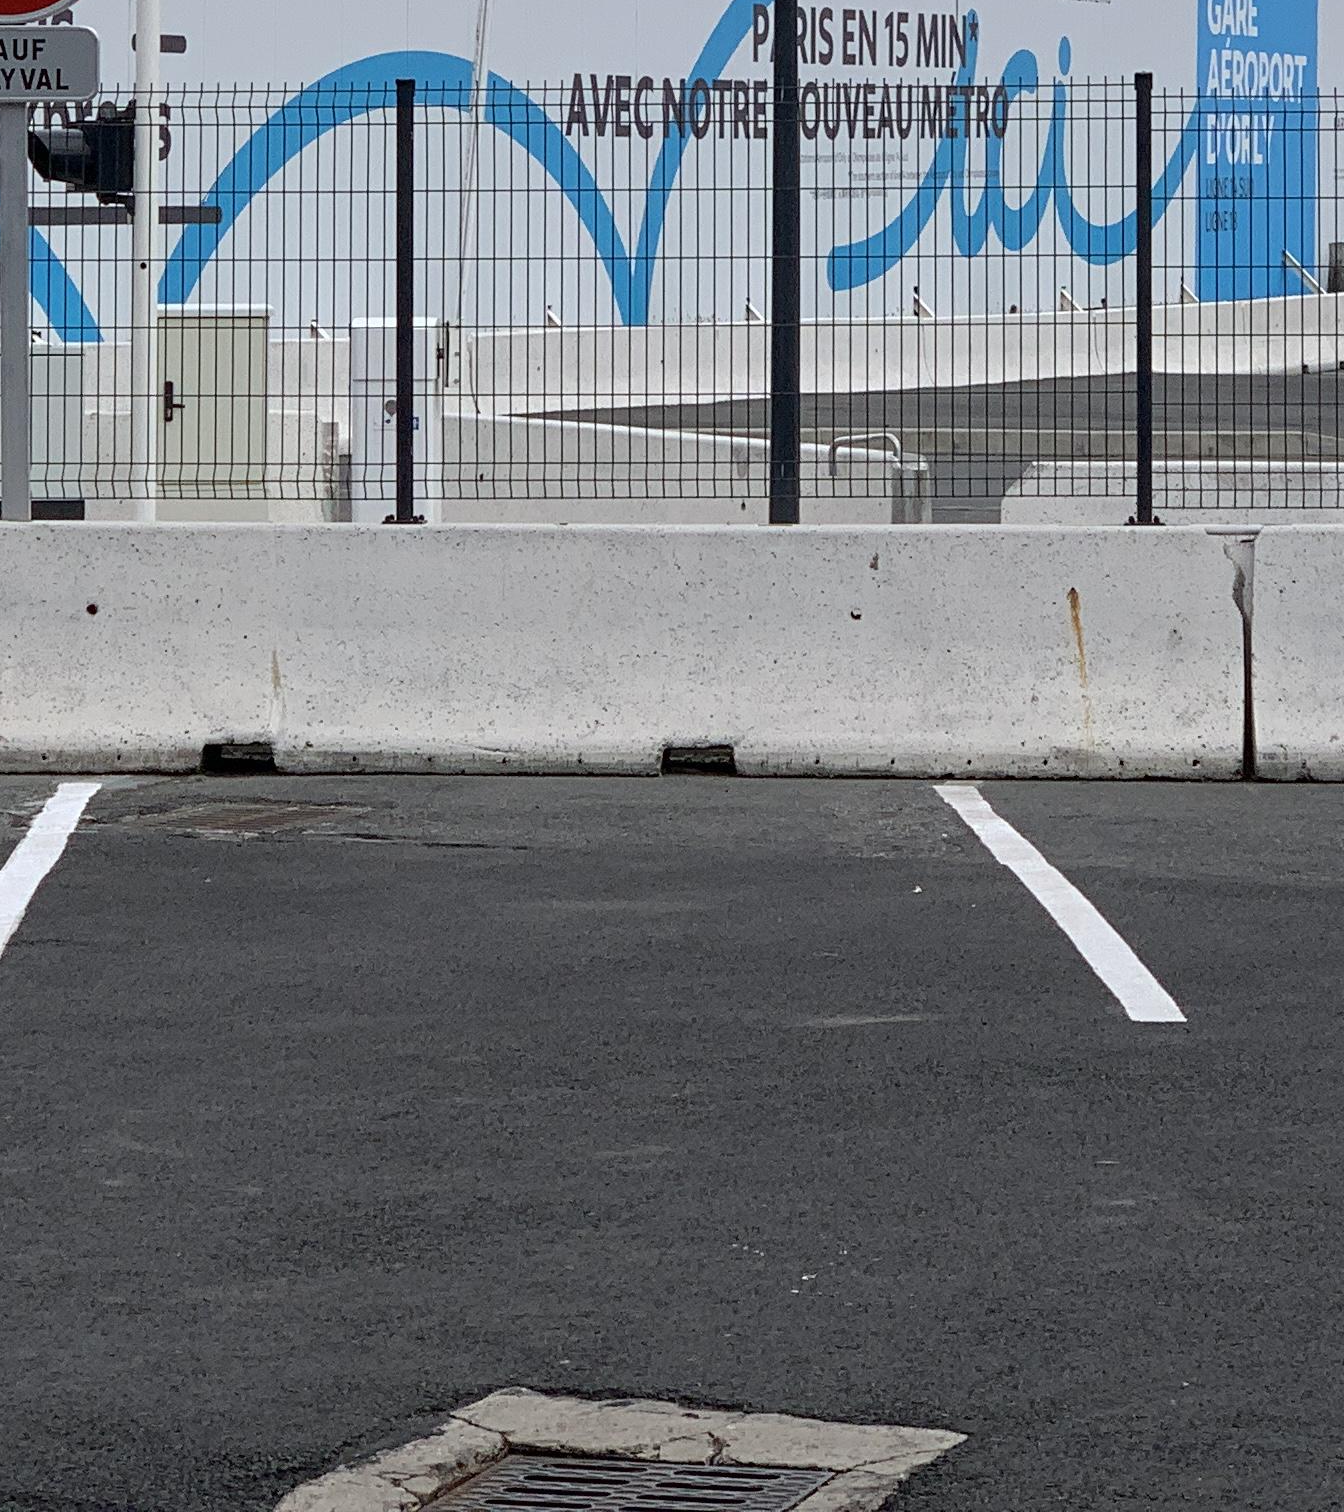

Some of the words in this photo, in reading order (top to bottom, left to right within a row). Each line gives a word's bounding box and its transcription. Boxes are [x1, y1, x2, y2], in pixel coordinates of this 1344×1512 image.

[753, 3, 834, 66] PRIS
[842, 8, 878, 67] EN
[884, 10, 909, 68] 15
[1206, 41, 1308, 104] AÉROPORT
[566, 72, 654, 139] AVEC
[663, 76, 768, 140] NOTRE
[794, 79, 913, 140] OUVEAU
[920, 71, 1009, 140] MÉTRO
[1206, 112, 1275, 165] D'ORLY
